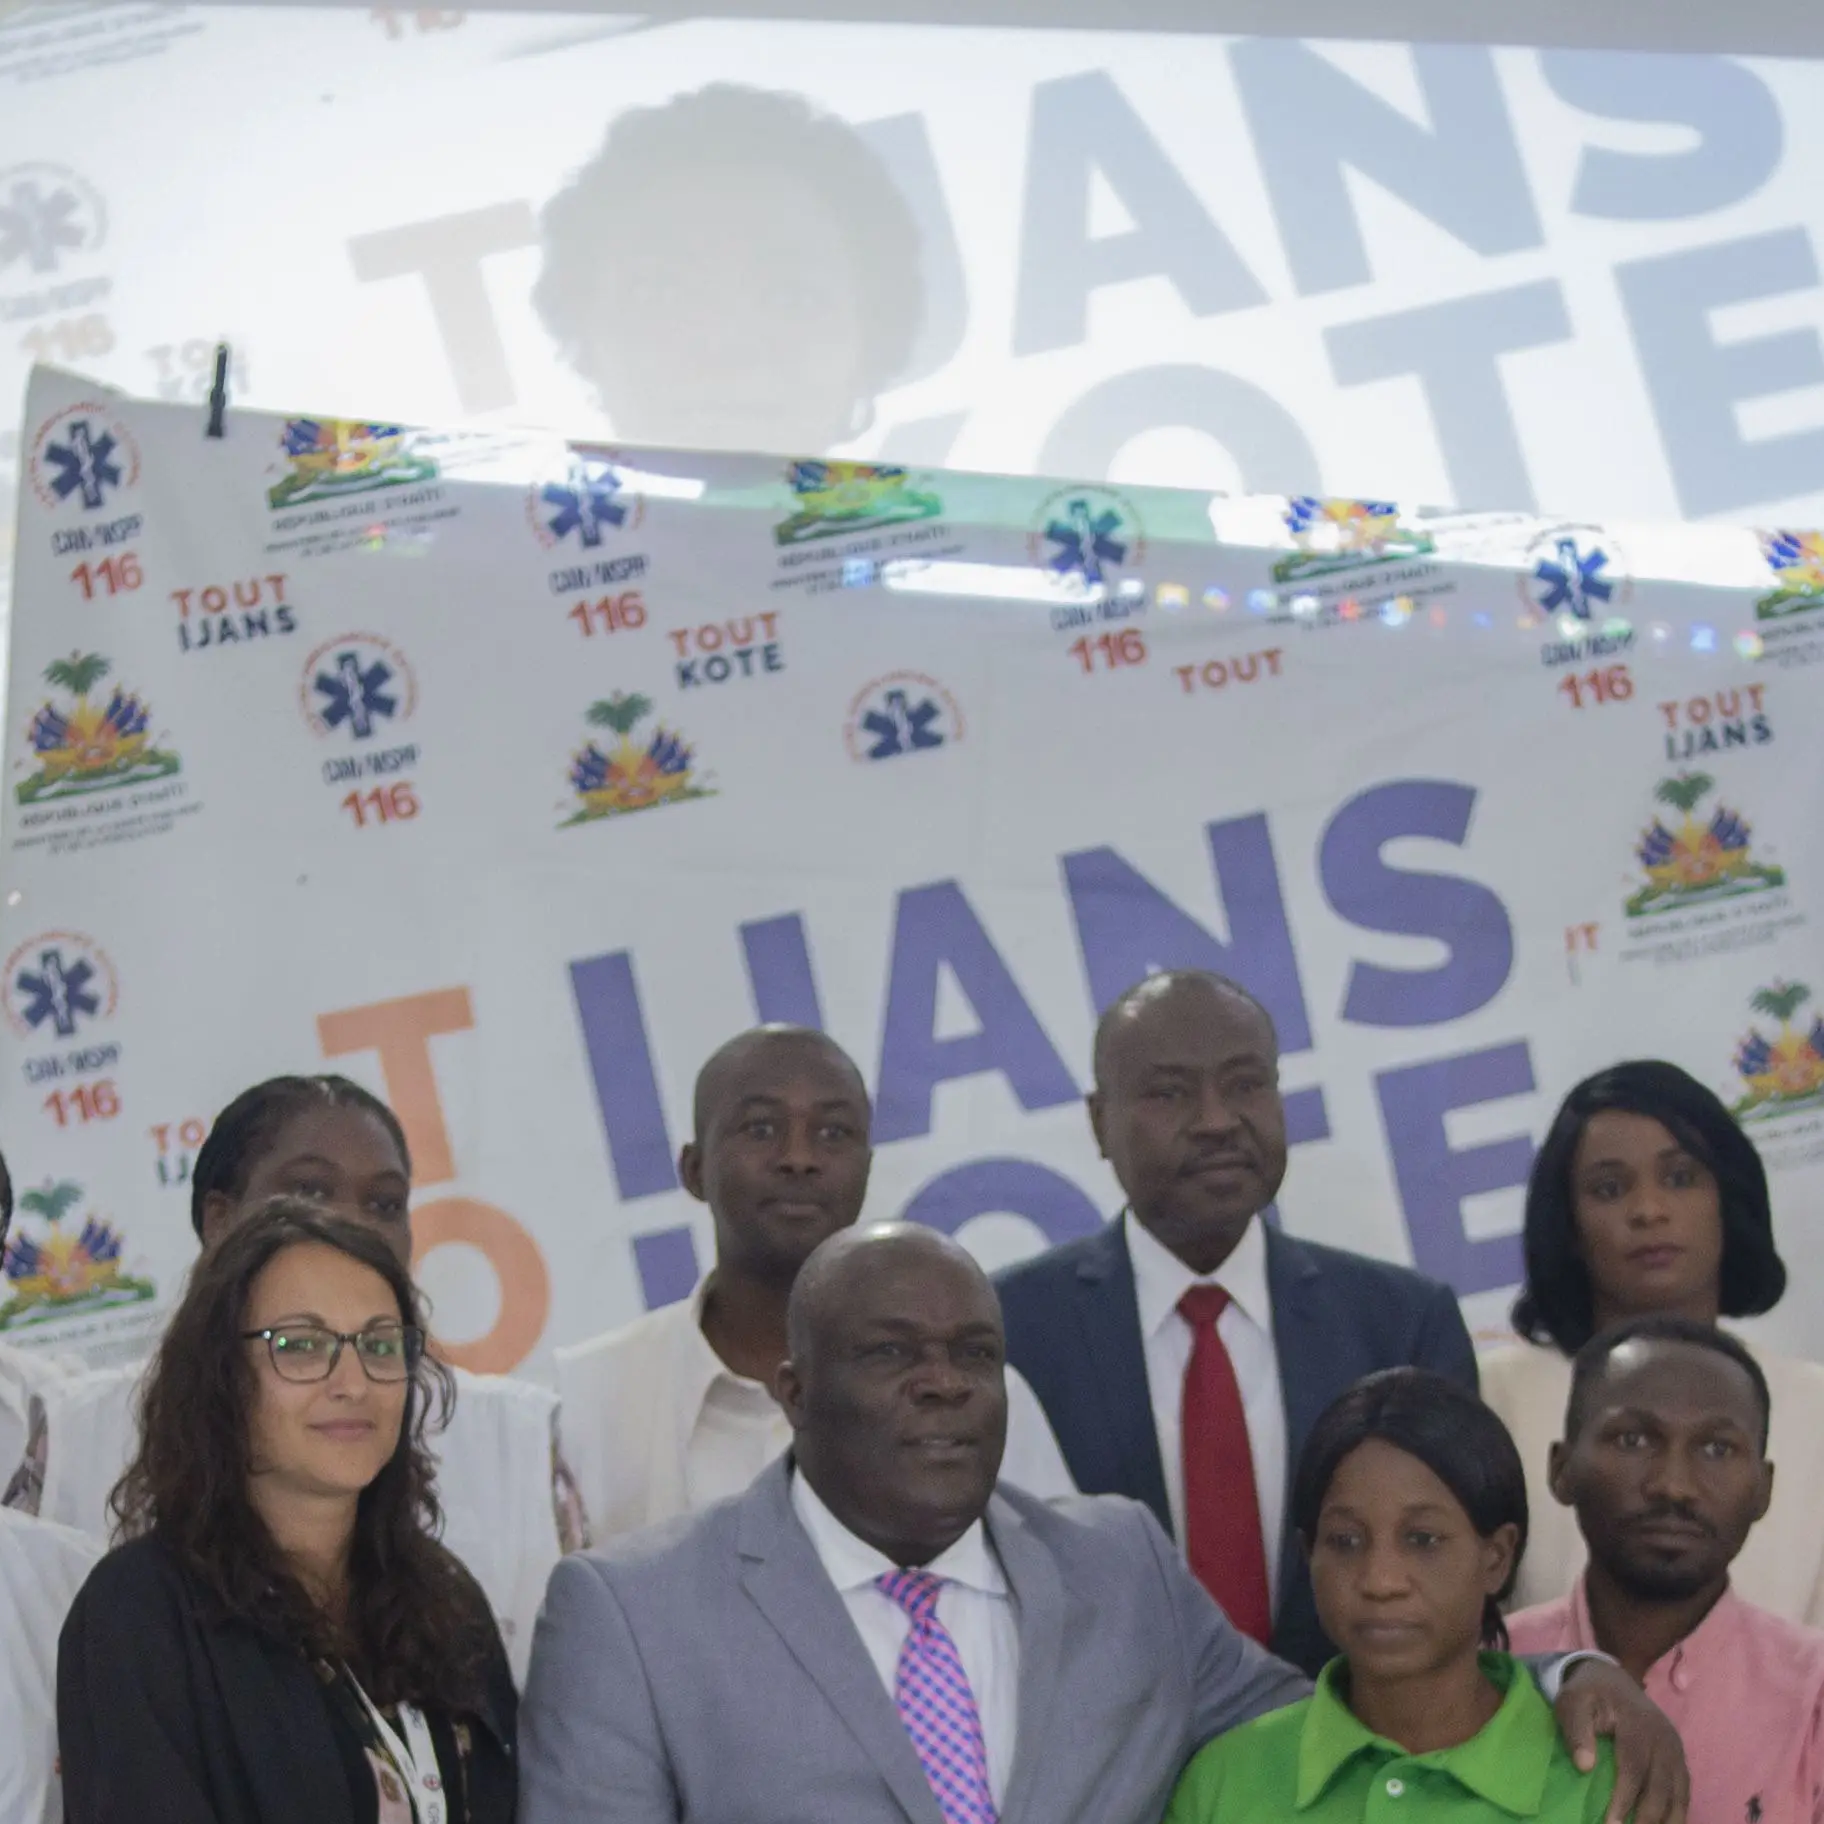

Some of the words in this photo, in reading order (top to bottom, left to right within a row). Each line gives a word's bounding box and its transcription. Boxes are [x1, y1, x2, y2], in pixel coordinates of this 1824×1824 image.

[71, 553, 143, 600] 116
[170, 574, 289, 618] TOUT
[177, 606, 297, 653] IJANS
[568, 591, 647, 637] 116
[669, 611, 782, 656] TOUT
[676, 643, 786, 689] KOTE
[1068, 628, 1147, 673] 116
[1175, 649, 1284, 693] TOUT
[1558, 664, 1634, 708] 116
[1658, 684, 1765, 727] TOUT
[1665, 715, 1772, 762] IJANS
[342, 781, 422, 827] 116
[43, 1080, 122, 1128] 116
